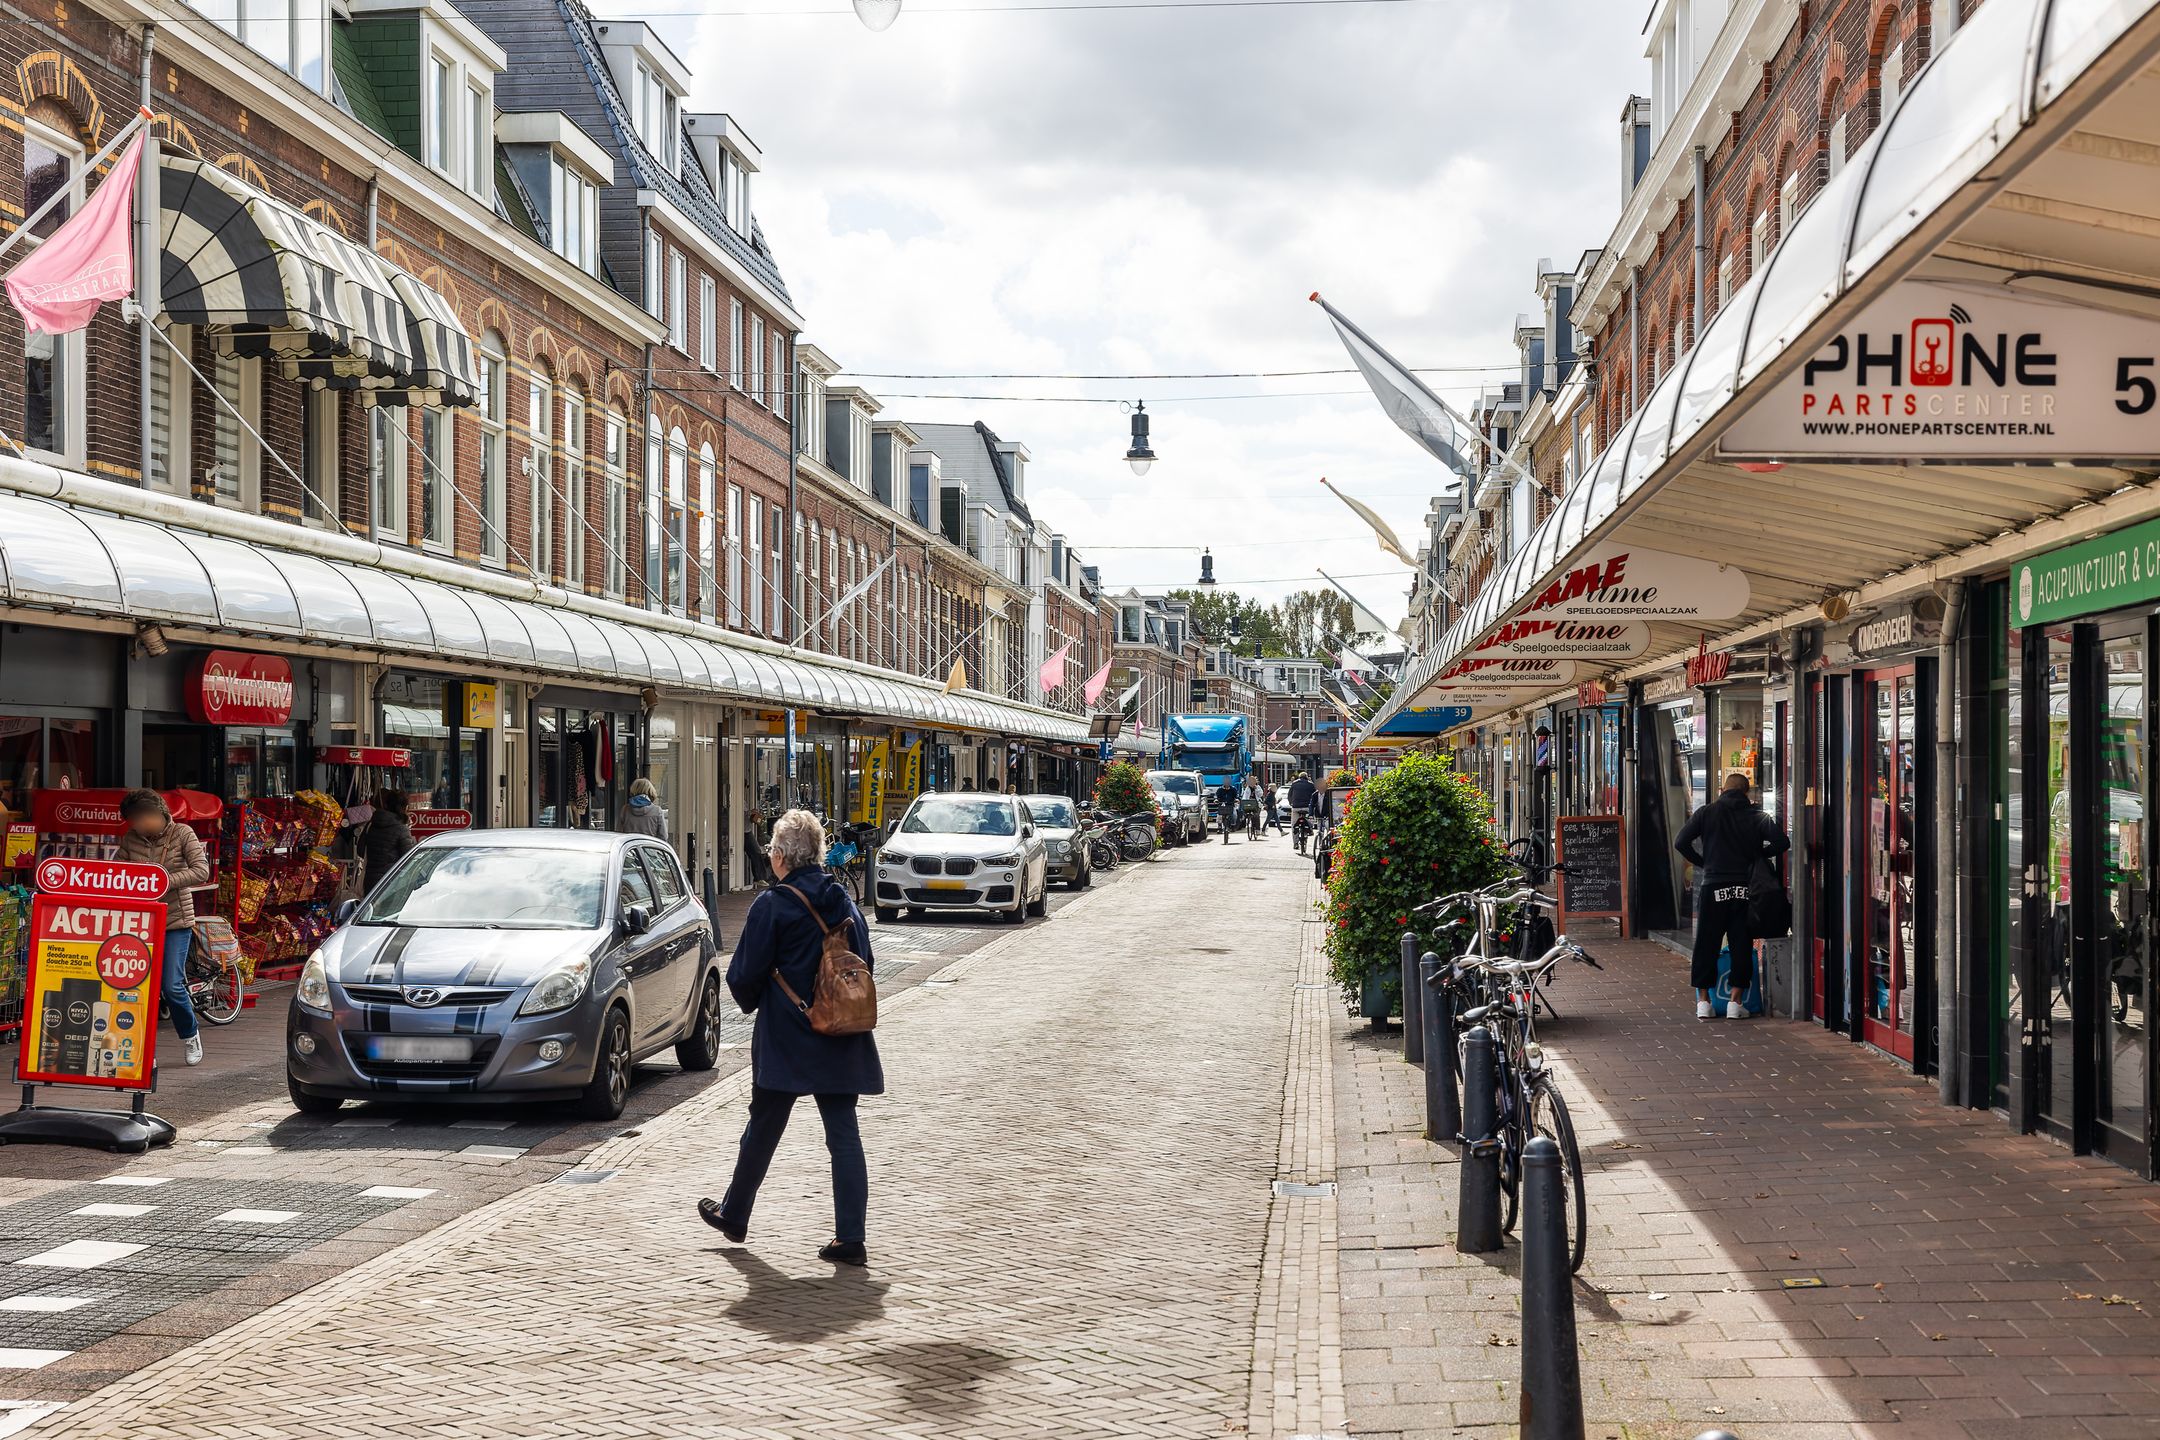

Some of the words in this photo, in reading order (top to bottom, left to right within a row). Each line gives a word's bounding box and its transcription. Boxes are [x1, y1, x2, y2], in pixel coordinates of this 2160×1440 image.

[2114, 357, 2157, 415] 5
[1803, 423, 2055, 436] WWW.PHONEPARTSCENTER.NL
[2038, 550, 2126, 605] ACUPUNCTUUR
[2132, 546, 2140, 582] &
[1514, 553, 1630, 617] AME
[1566, 607, 1699, 615] SPEELGOEDSPECIAALZAAK
[1858, 614, 1912, 652] KINDERBOEKEN
[1512, 642, 1631, 654] Speelgoedspeciaalzaak
[1469, 673, 1561, 681] Speelgoedspeciaalzaak
[227, 669, 287, 708] Kruidvat
[1455, 707, 1467, 717] 39
[1106, 743, 1113, 754] P
[74, 808, 122, 821] Kruidvat
[418, 812, 467, 825] Kruidvat
[10, 825, 36, 833] ACTIE!
[69, 866, 159, 892] Kruidvat
[49, 906, 151, 940] ACTIE!
[47, 944, 65, 952] Nivea
[111, 943, 121, 955] 4
[121, 949, 138, 957] VOOR
[46, 951, 79, 960] deodorant
